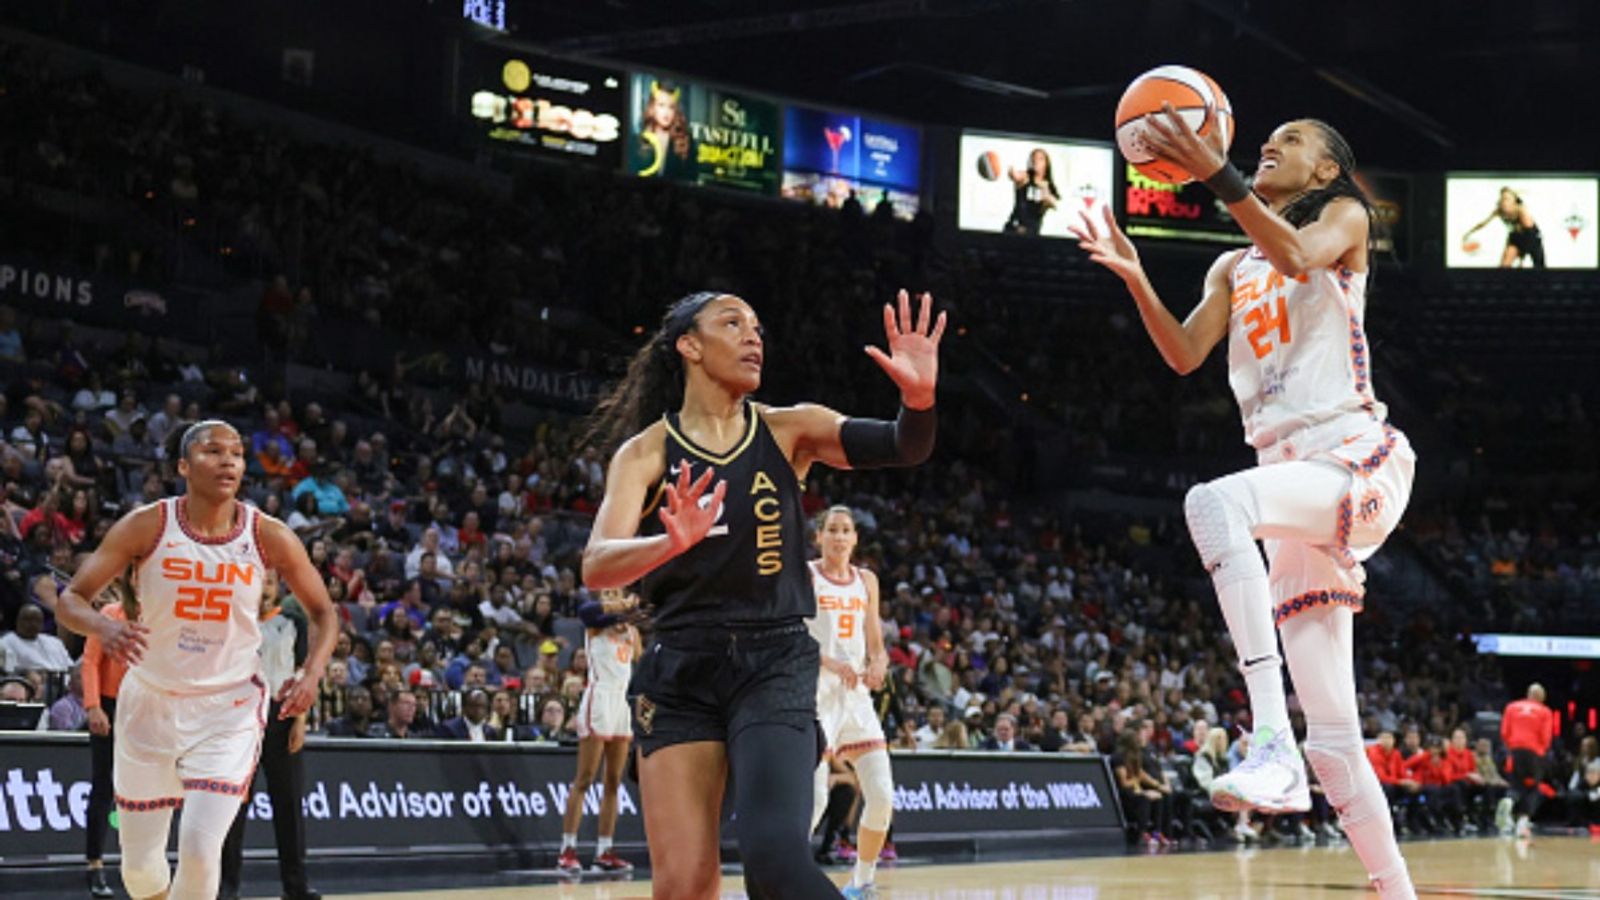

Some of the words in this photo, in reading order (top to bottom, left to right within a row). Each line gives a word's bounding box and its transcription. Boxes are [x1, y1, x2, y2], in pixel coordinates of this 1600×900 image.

[1243, 296, 1291, 359] 24
[465, 356, 594, 401] MANDALAY
[749, 470, 784, 576] ACES
[162, 557, 254, 586] SUN
[174, 587, 233, 622] 25
[838, 614, 854, 638] 9
[339, 781, 454, 819] Advisor
[463, 782, 492, 817] of
[497, 781, 547, 818] the
[546, 783, 638, 816] WNA
[934, 781, 998, 810] Advisor
[1000, 781, 1019, 810] of
[1020, 781, 1049, 810] the
[1046, 782, 1102, 809] WNBA
